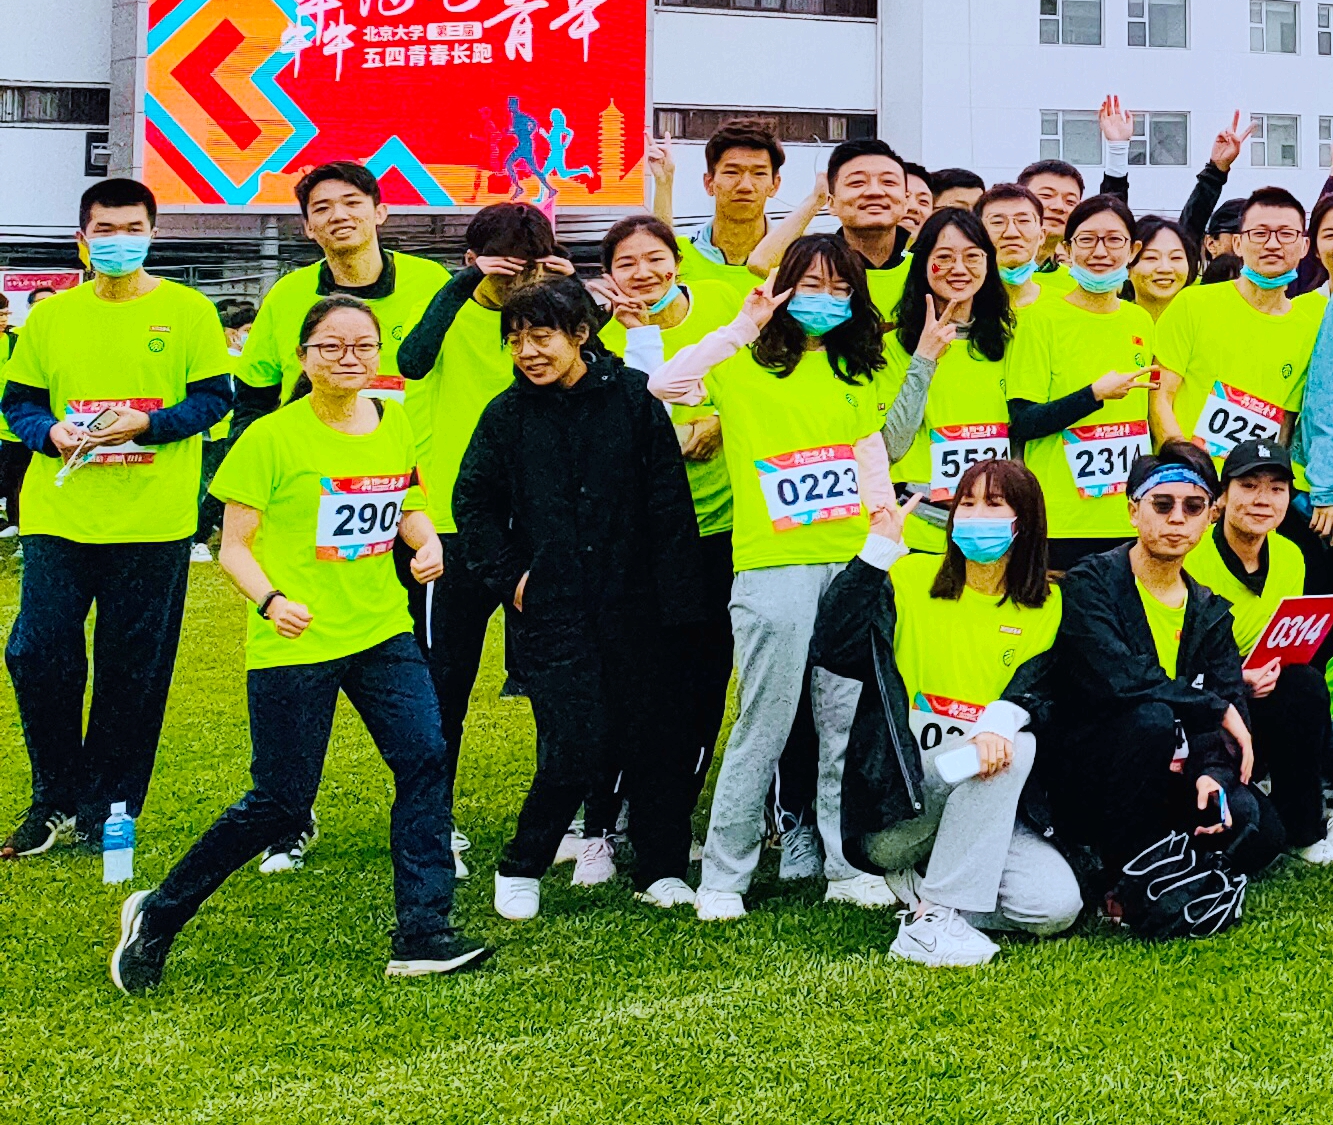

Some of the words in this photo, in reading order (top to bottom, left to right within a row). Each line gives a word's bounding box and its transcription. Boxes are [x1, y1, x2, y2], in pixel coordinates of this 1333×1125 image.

[363, 24, 424, 42] 北京大学
[361, 43, 493, 68] 五四青春长跑
[777, 467, 859, 507] 0223
[332, 501, 401, 537] 290
[1266, 613, 1331, 649] 0314
